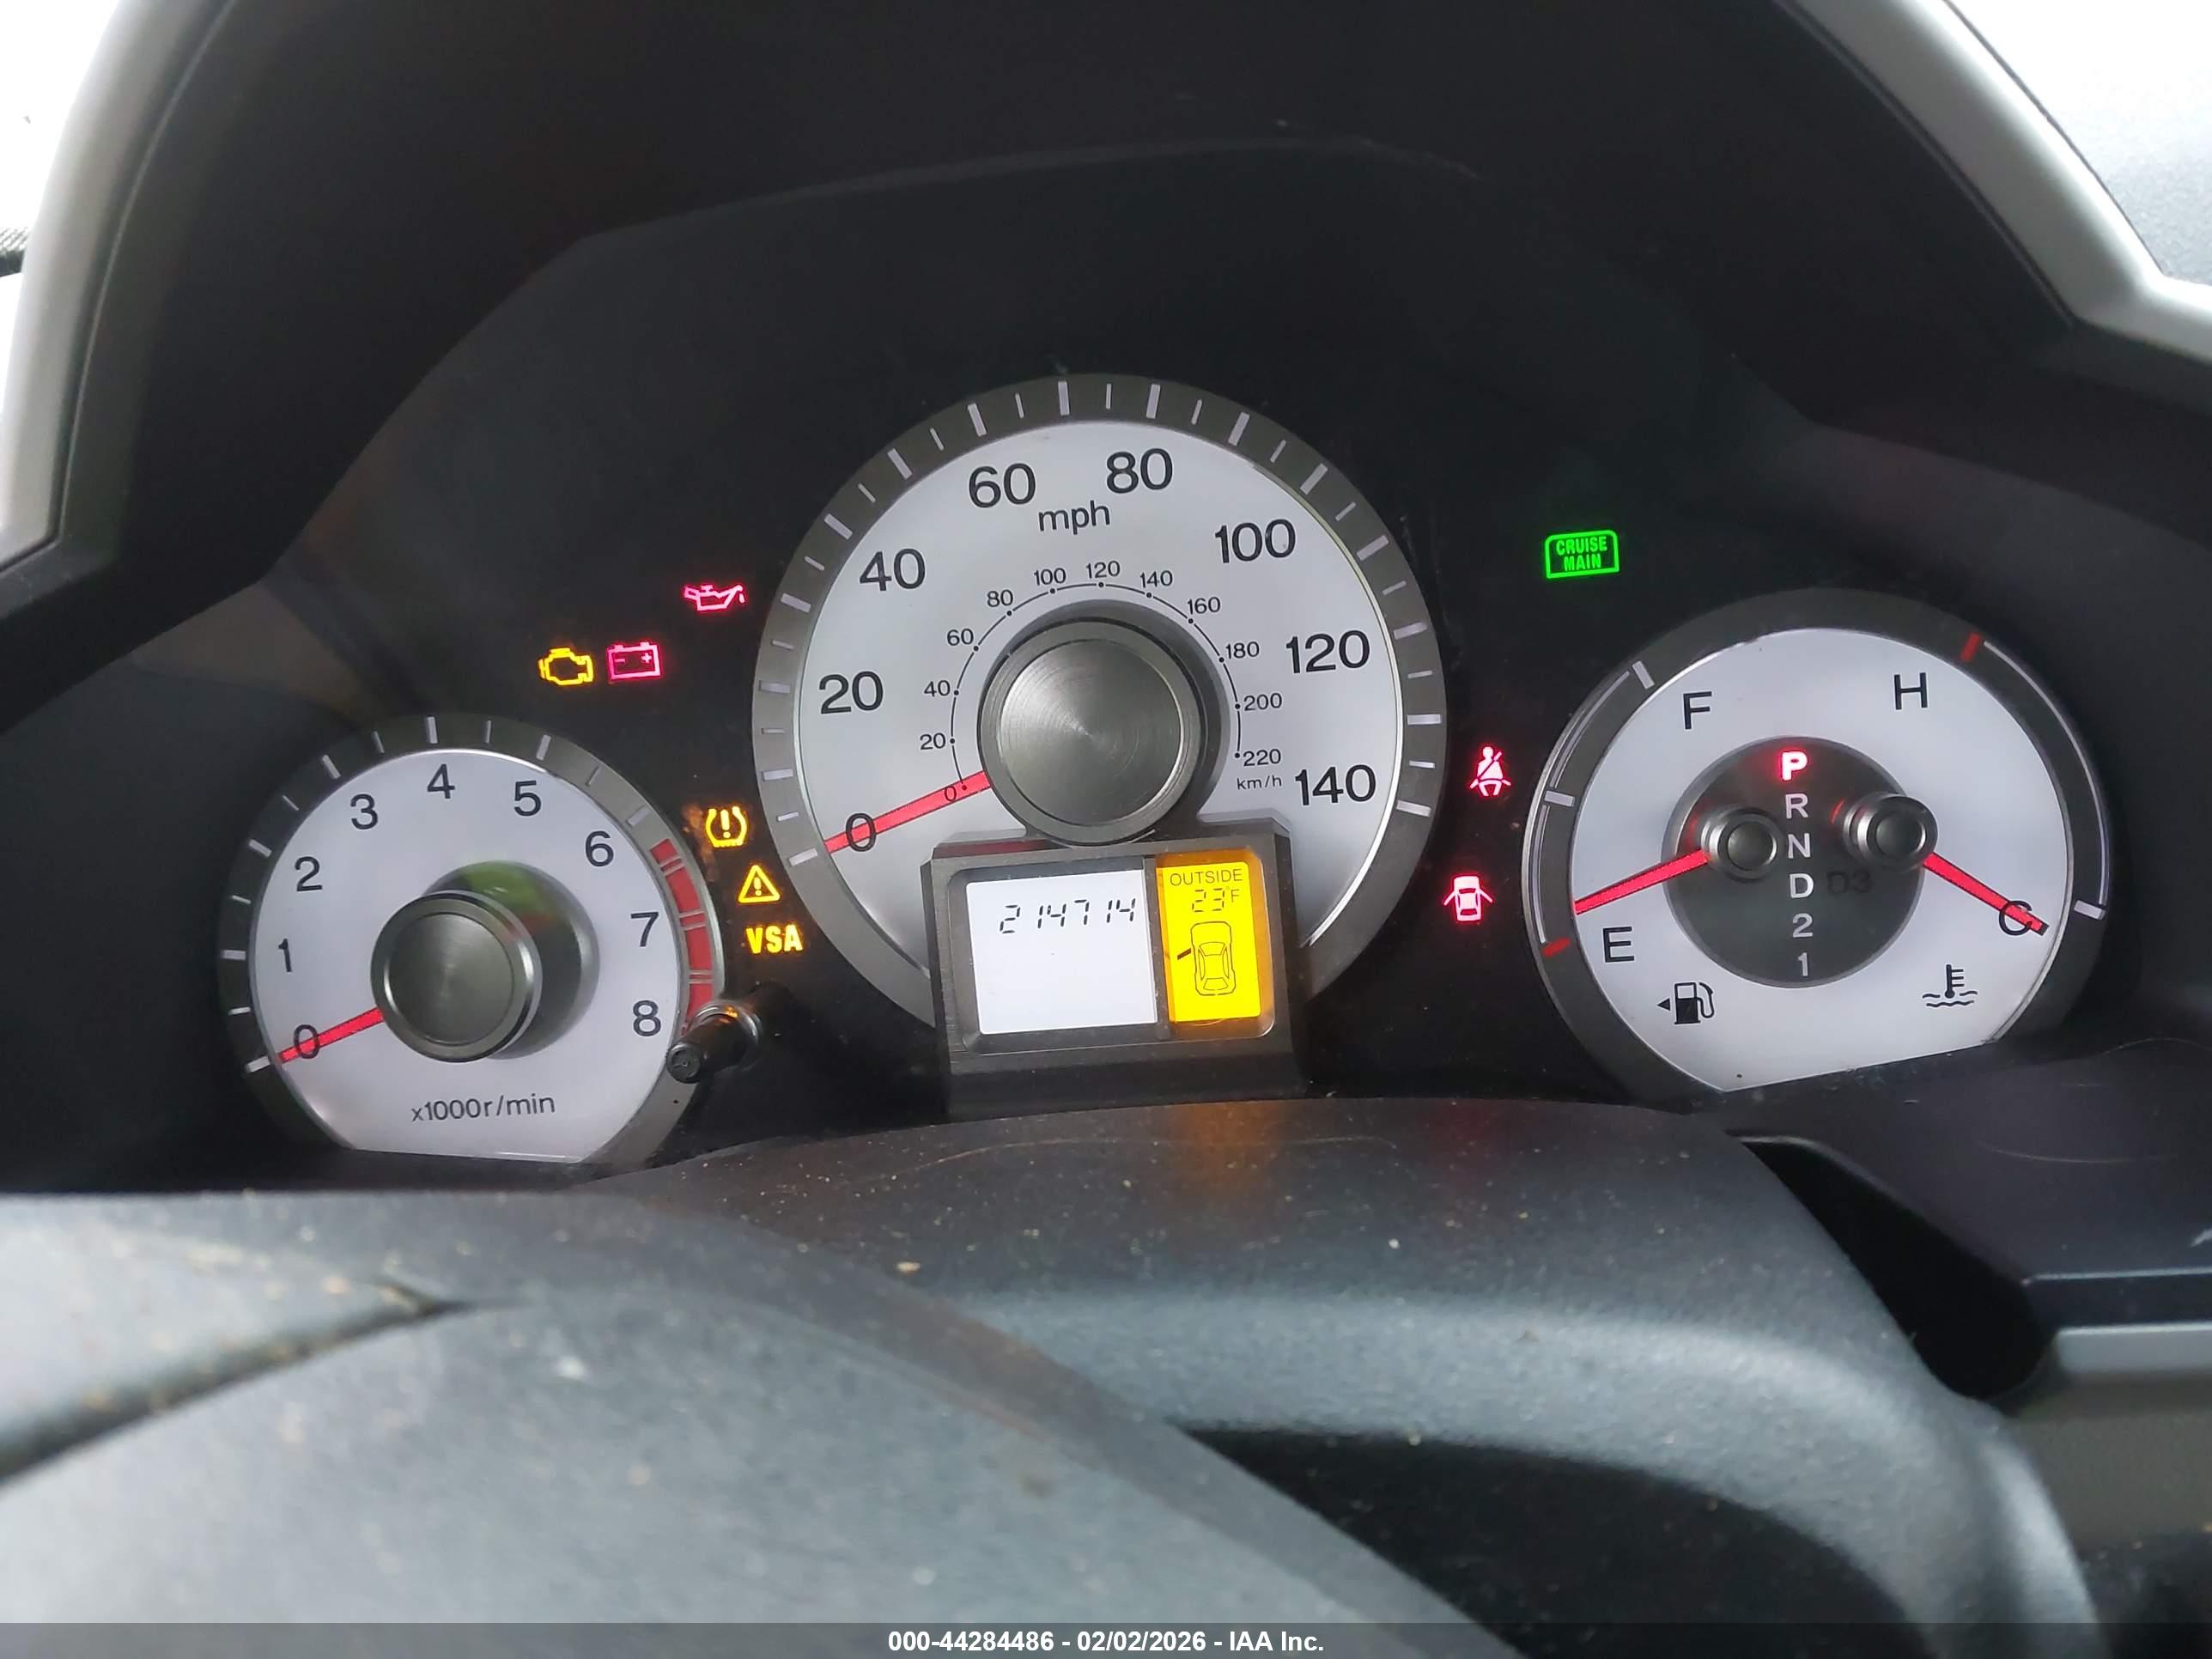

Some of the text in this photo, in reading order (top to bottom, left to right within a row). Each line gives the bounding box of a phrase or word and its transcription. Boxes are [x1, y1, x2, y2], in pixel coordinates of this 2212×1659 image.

[969, 464, 1036, 507] 60
[1107, 448, 1172, 494] 80
[1039, 500, 1109, 535] mph
[1215, 520, 1295, 563] 100
[1556, 536, 1607, 555] CRUISE
[860, 549, 925, 591] 40
[1034, 568, 1066, 586] 100
[1086, 561, 1120, 579] 120
[1565, 553, 1601, 571] MAIN
[1140, 570, 1172, 588] 140
[987, 590, 1014, 607] 80
[1188, 597, 1220, 615] 160
[947, 629, 974, 646] 60
[1226, 641, 1259, 659] 180
[1286, 630, 1370, 673] 120
[819, 672, 883, 714] 20
[924, 680, 951, 696] 40
[1244, 693, 1282, 711] 200
[1894, 672, 1927, 710] H
[1683, 691, 1711, 729] F
[920, 732, 945, 750] 20
[1243, 749, 1281, 766] 220
[1781, 751, 1808, 781] P
[428, 763, 455, 799] 4
[943, 785, 957, 803] 0
[1237, 775, 1281, 790] km/h
[1295, 765, 1376, 805] 140
[350, 794, 378, 830] 3
[514, 781, 541, 816] 5
[1785, 793, 1808, 818] R
[846, 812, 877, 851] 0
[1788, 833, 1810, 858] N
[586, 831, 614, 866] 6
[295, 856, 322, 891] 2
[1170, 869, 1243, 886] OUTSIDE
[1790, 873, 1814, 897] D
[631, 912, 659, 947] 7
[1000, 898, 1135, 933] 214714
[1793, 914, 1813, 937] 2
[1998, 901, 2033, 937] C
[746, 924, 803, 954] VSA
[1603, 927, 1634, 963] E
[278, 939, 292, 972] 1
[1798, 952, 1808, 975] 1
[633, 1000, 661, 1036] 8
[292, 1024, 319, 1060] 0
